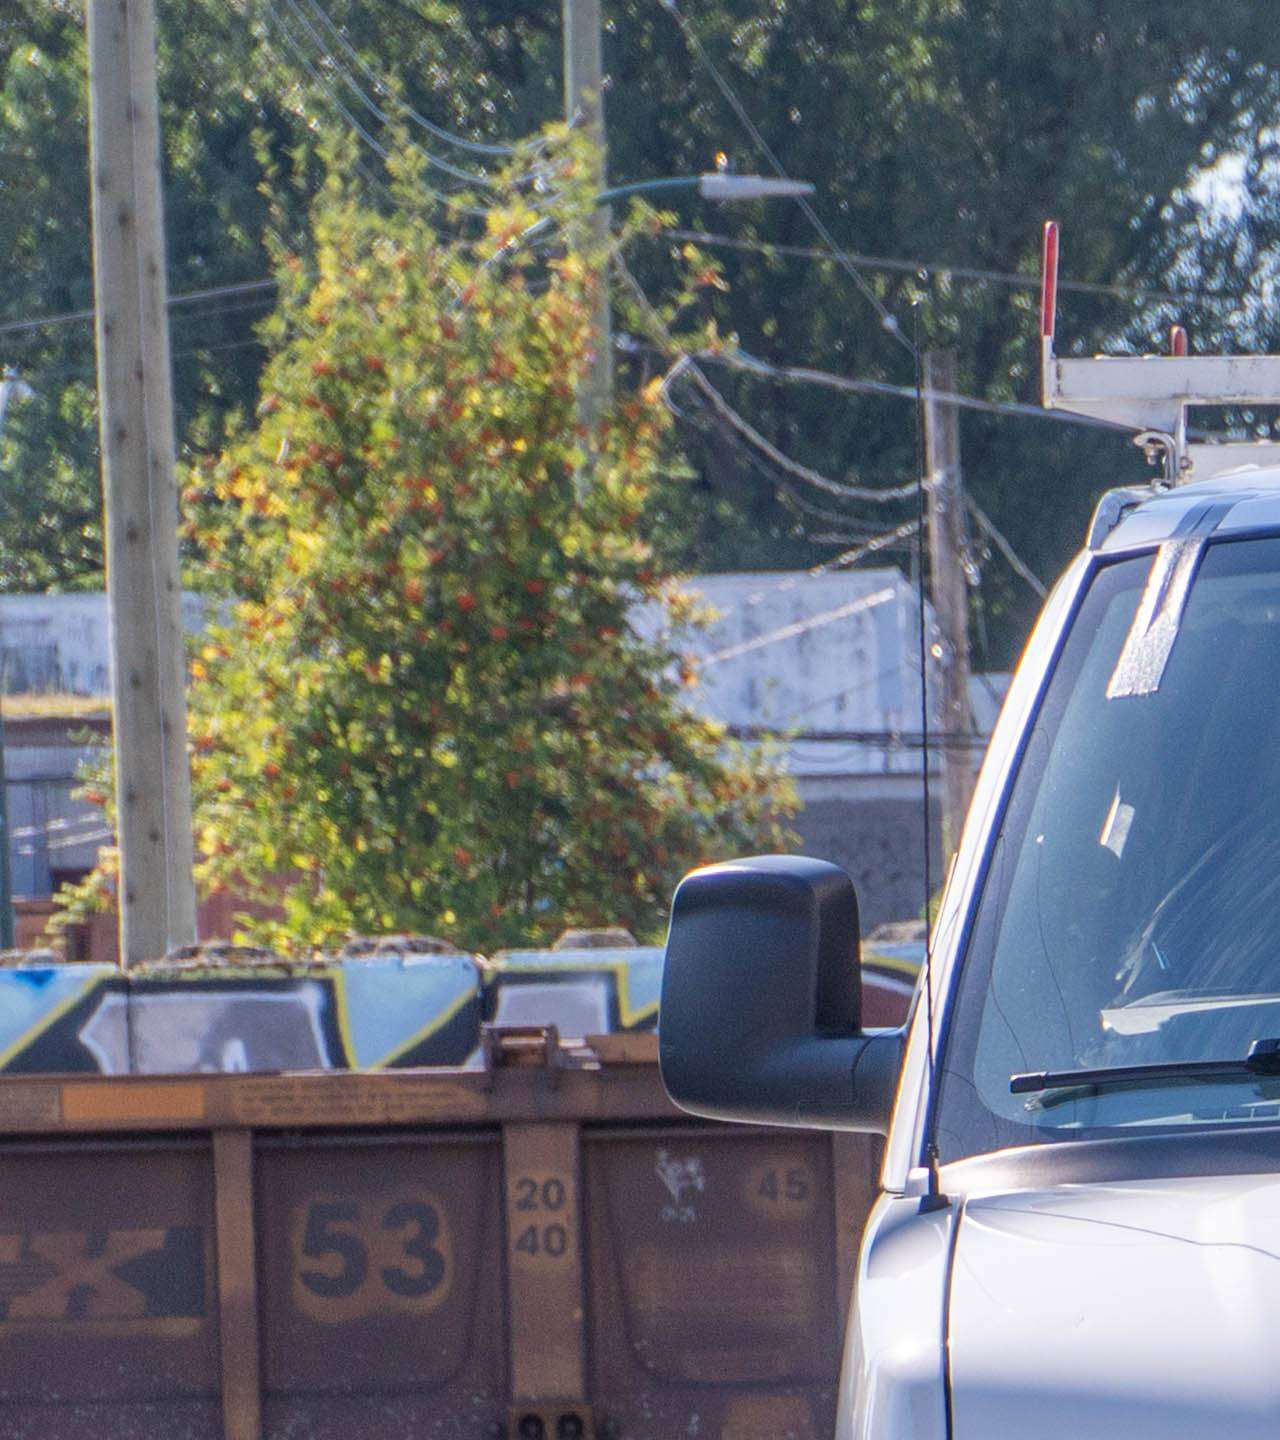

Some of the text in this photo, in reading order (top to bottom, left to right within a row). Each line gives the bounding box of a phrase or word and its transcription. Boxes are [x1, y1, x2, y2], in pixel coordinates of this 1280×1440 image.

[515, 1178, 566, 1211] 20
[757, 1167, 807, 1201] 45
[299, 1200, 447, 1299] 53
[514, 1224, 566, 1258] 40
